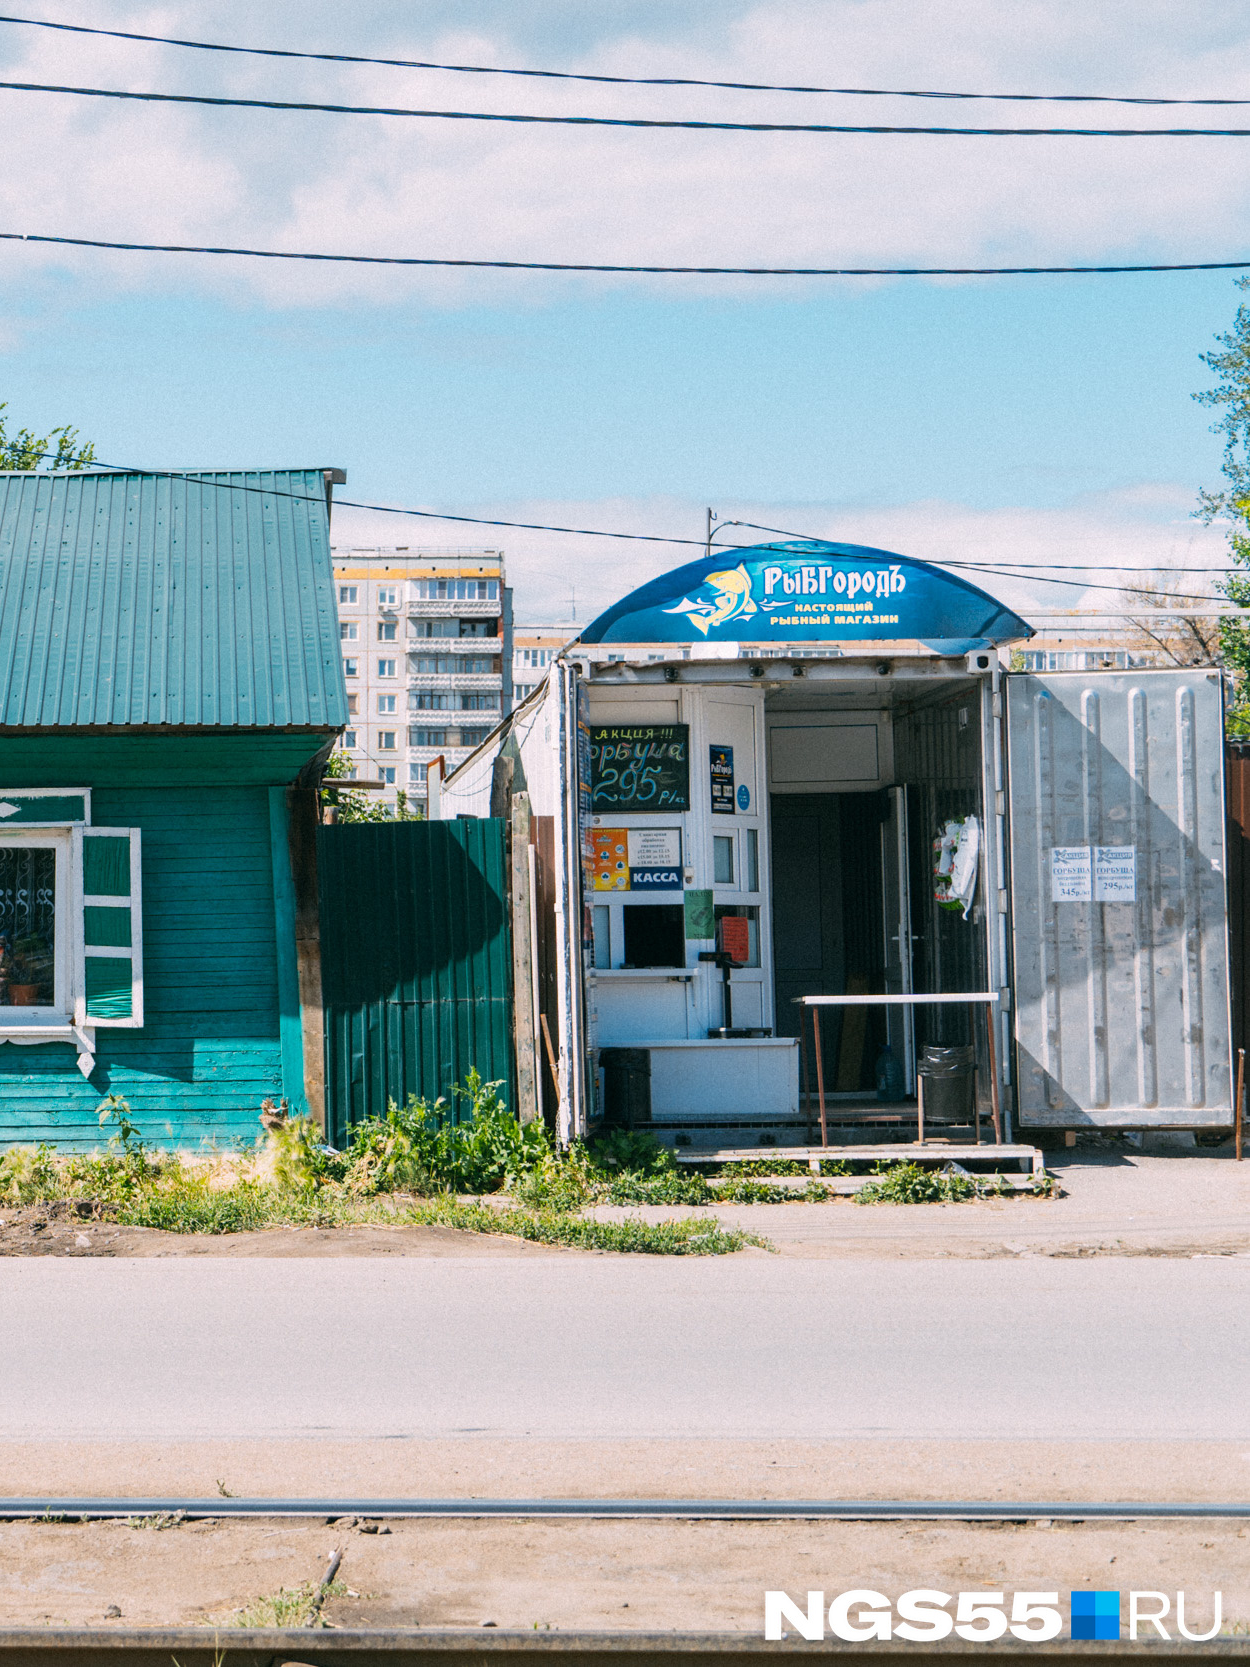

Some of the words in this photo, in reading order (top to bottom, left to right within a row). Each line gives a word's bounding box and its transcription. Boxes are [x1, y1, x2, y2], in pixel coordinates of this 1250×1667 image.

[794, 601, 874, 613] НАСТОЯЩИЙ
[770, 614, 831, 625] РЫБНЫЙ
[834, 614, 899, 625] МАГАЗИН
[595, 728, 654, 740] АКЦИЯ
[590, 742, 685, 772] орбуша
[592, 766, 662, 802] 295
[1053, 867, 1090, 875] ГОРБУША
[633, 872, 679, 883] КАССА
